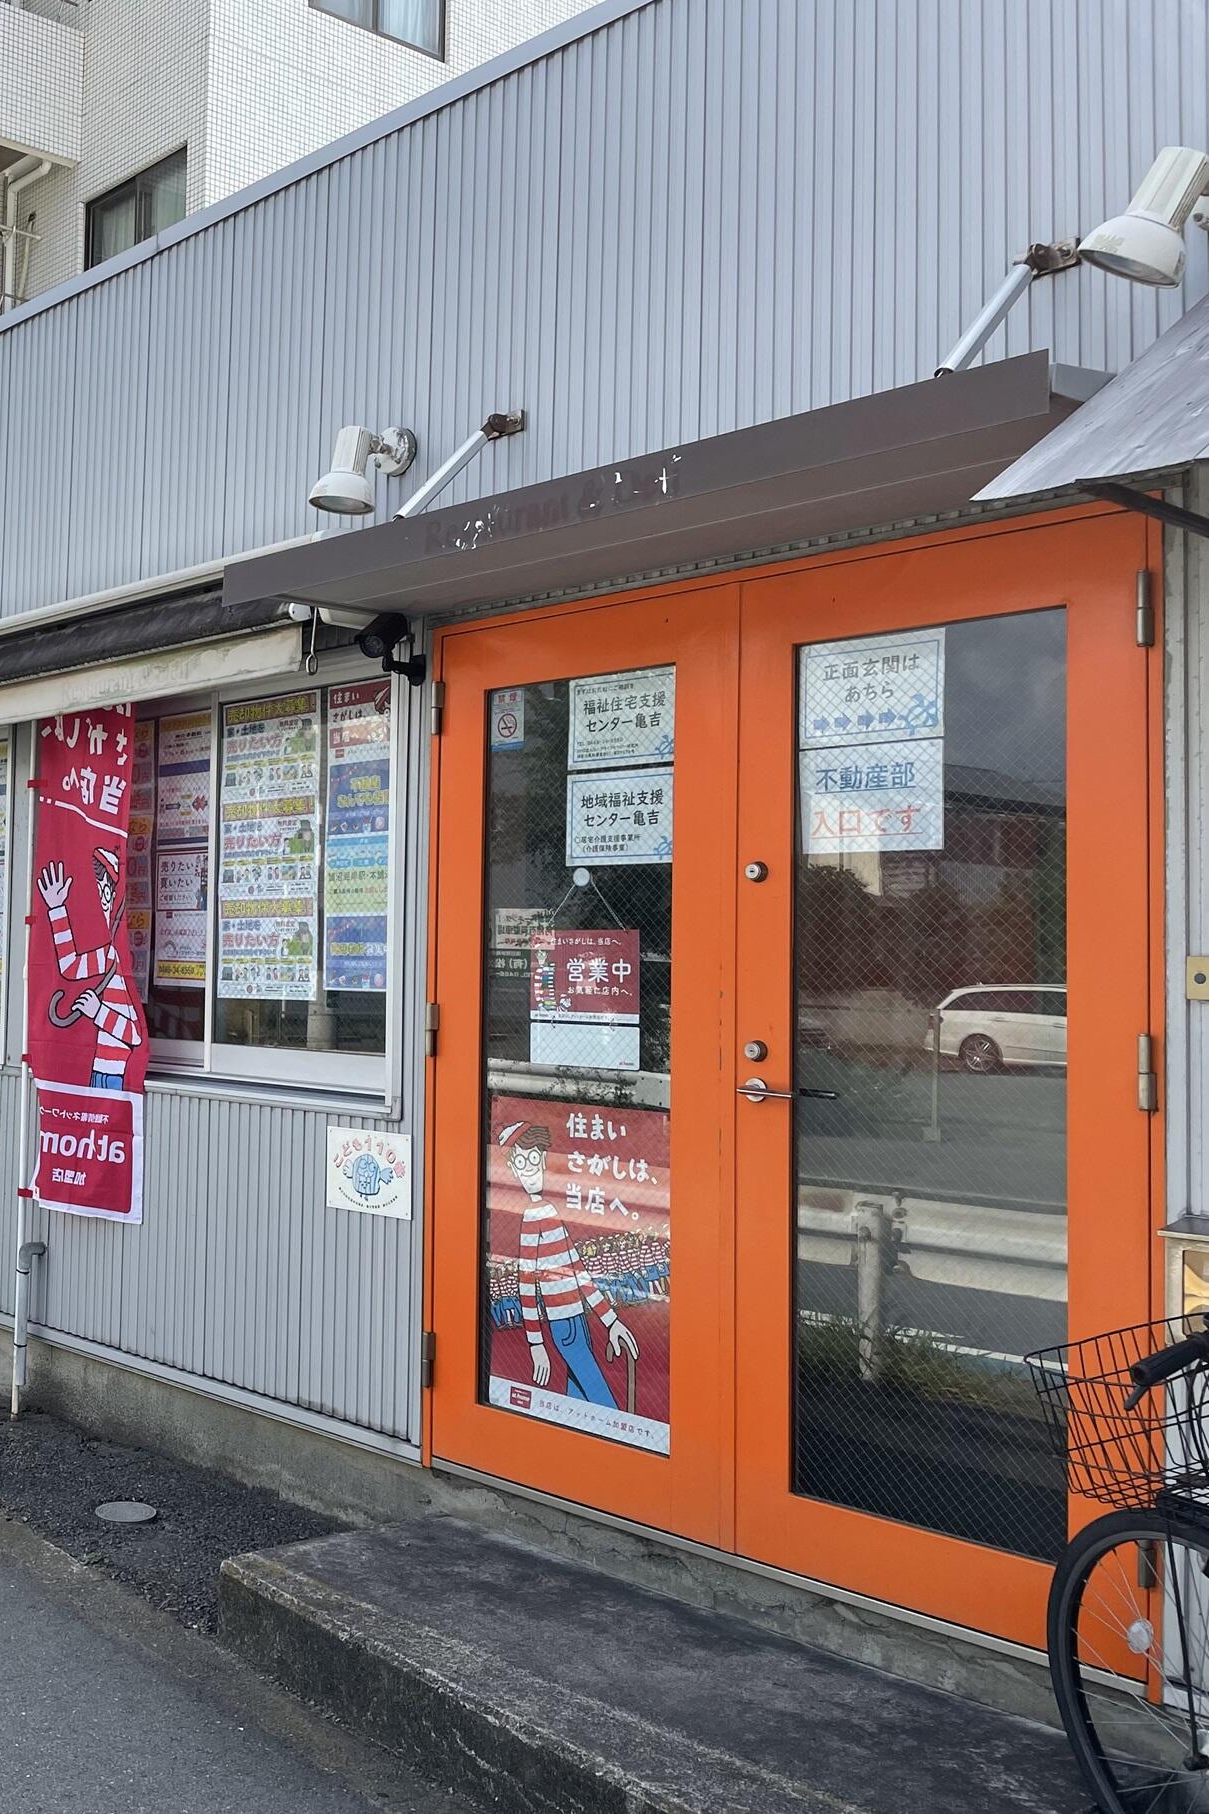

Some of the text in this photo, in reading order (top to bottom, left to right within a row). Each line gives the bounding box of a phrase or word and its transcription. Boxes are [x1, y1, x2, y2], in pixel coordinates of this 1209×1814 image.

[823, 653, 919, 681] 正面玄関は
[333, 692, 359, 704] 住まい
[583, 691, 666, 715] 福祉住宅支援
[845, 681, 894, 703] あちら
[585, 712, 662, 732] センター亀吉
[815, 762, 915, 791] 不動産部
[581, 788, 664, 808] 地域福祉支援
[583, 809, 660, 827] センター亀吉
[812, 805, 920, 836] 入口です
[160, 860, 194, 873] 売りたい
[160, 877, 193, 889] 買いたい
[550, 937, 622, 946] 住まいさがしは、当店へ。
[567, 958, 631, 983] 営業中
[566, 1113, 626, 1139] 住まい
[567, 1151, 658, 1185] さがしは、
[565, 1182, 639, 1221] 当店へ。
[540, 1401, 655, 1439] 当店は、アットホーム加盟店です。
